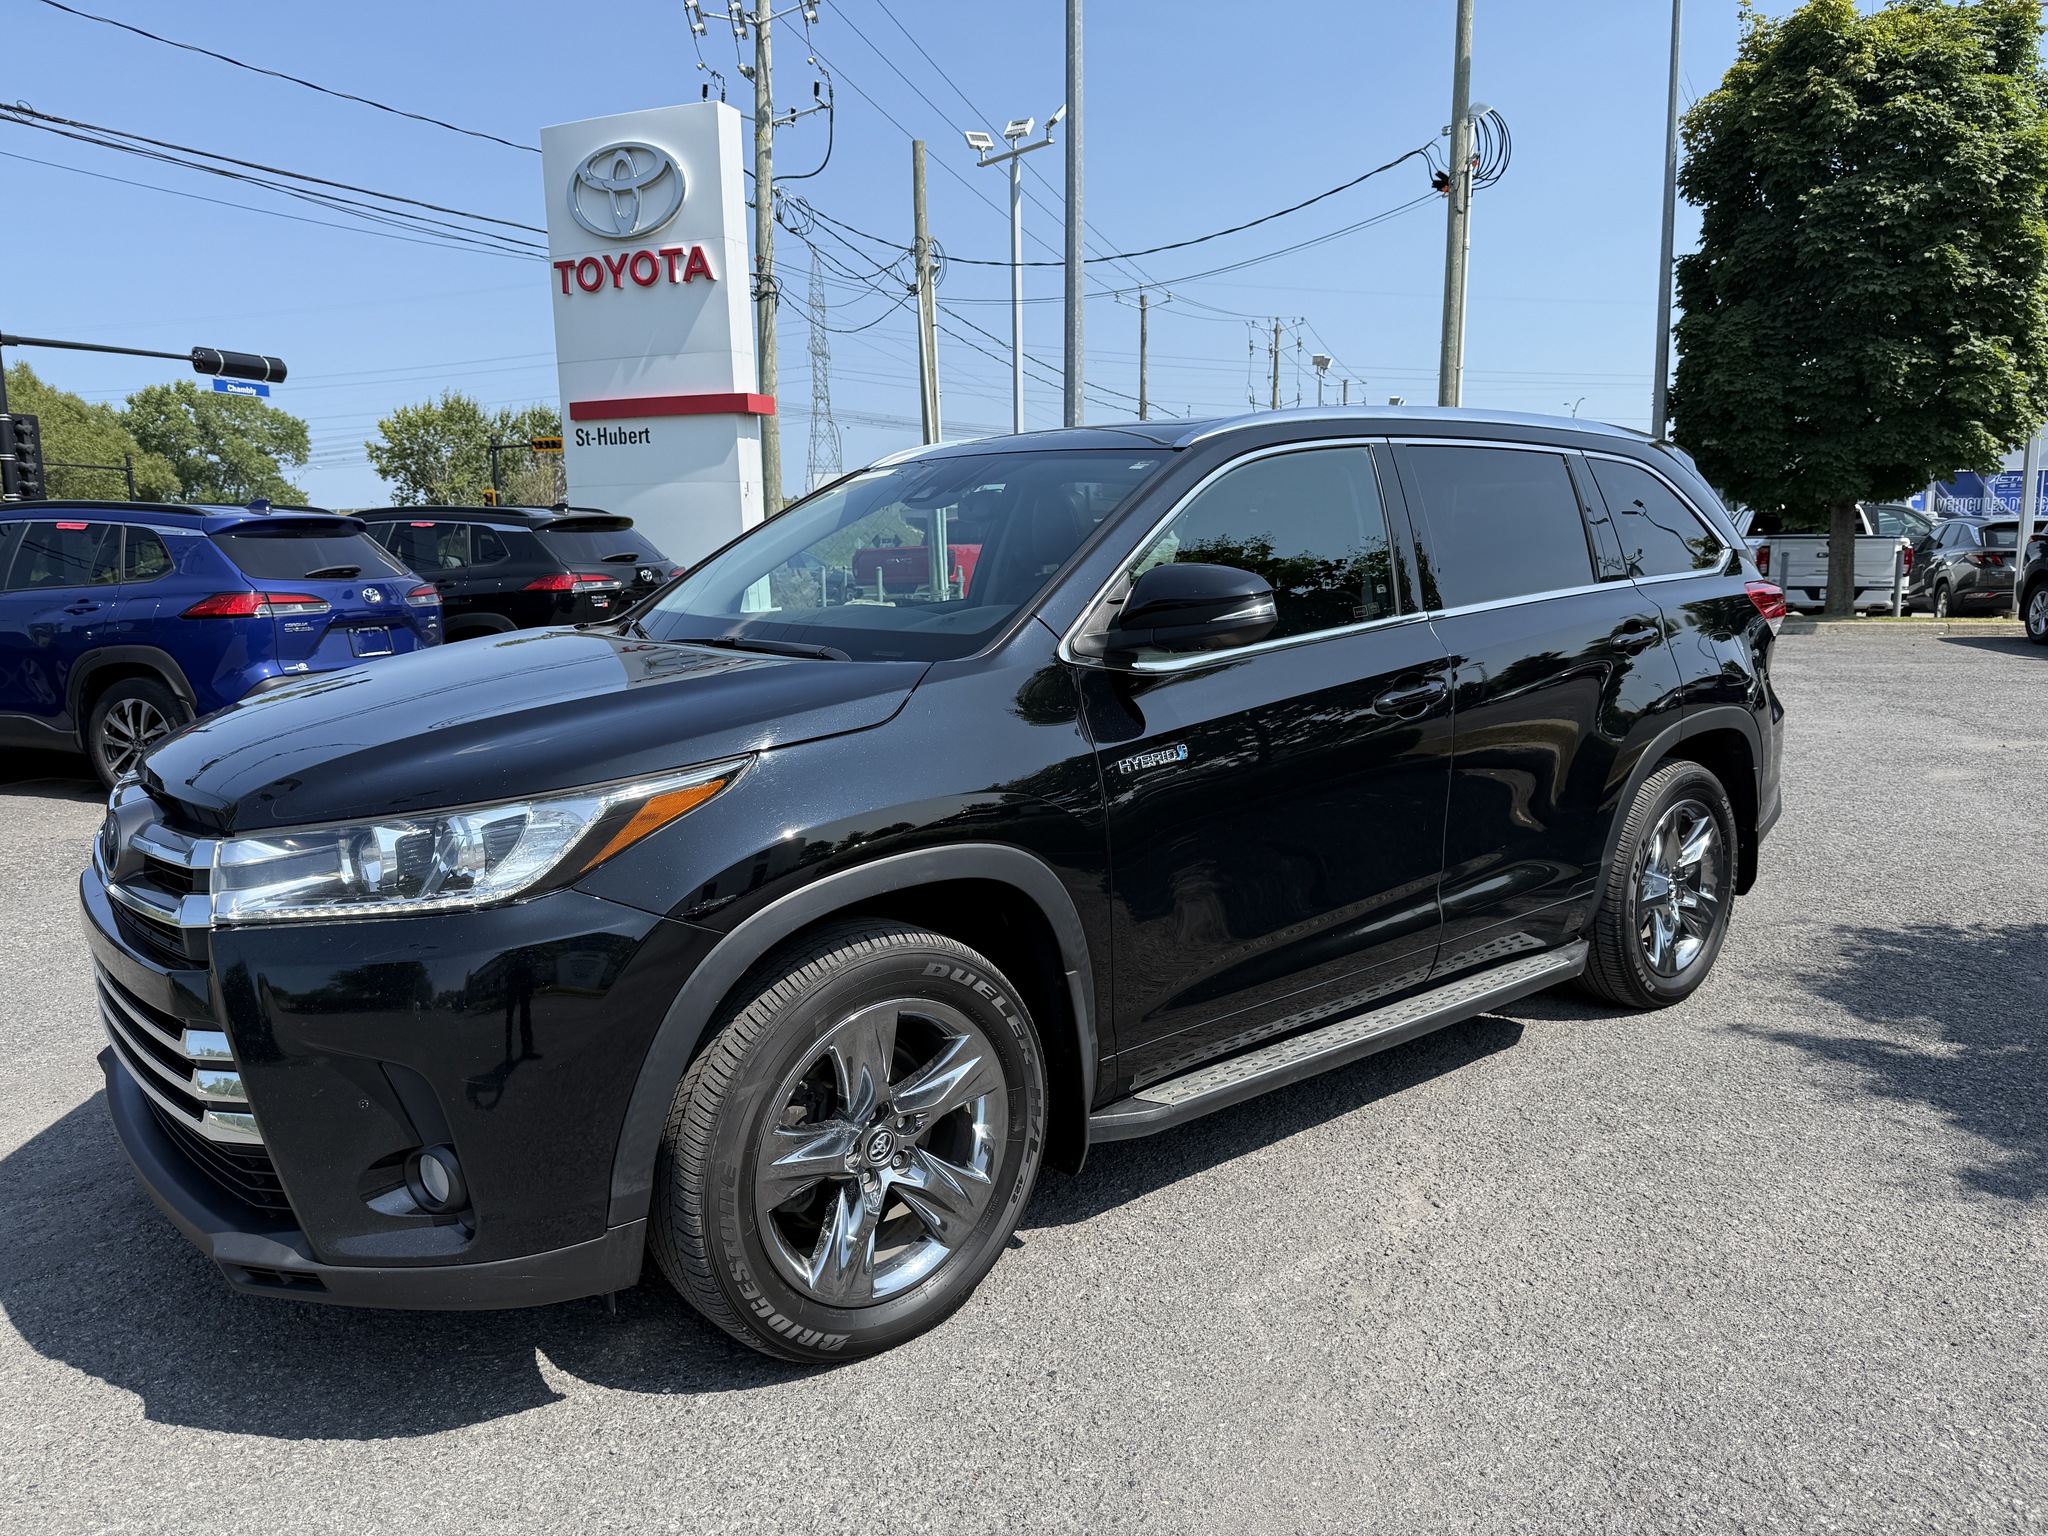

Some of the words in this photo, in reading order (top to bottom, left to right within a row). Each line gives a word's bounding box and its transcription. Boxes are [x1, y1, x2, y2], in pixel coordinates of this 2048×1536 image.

[553, 245, 717, 296] TOYOTA
[226, 383, 258, 396] Chambly
[575, 425, 651, 447] St-Hubert
[1936, 494, 2007, 514] VÉHICULES
[1117, 748, 1179, 776] HYBRID
[921, 961, 1036, 1066] DUELER
[718, 1160, 852, 1352] BRIDGESTONE
